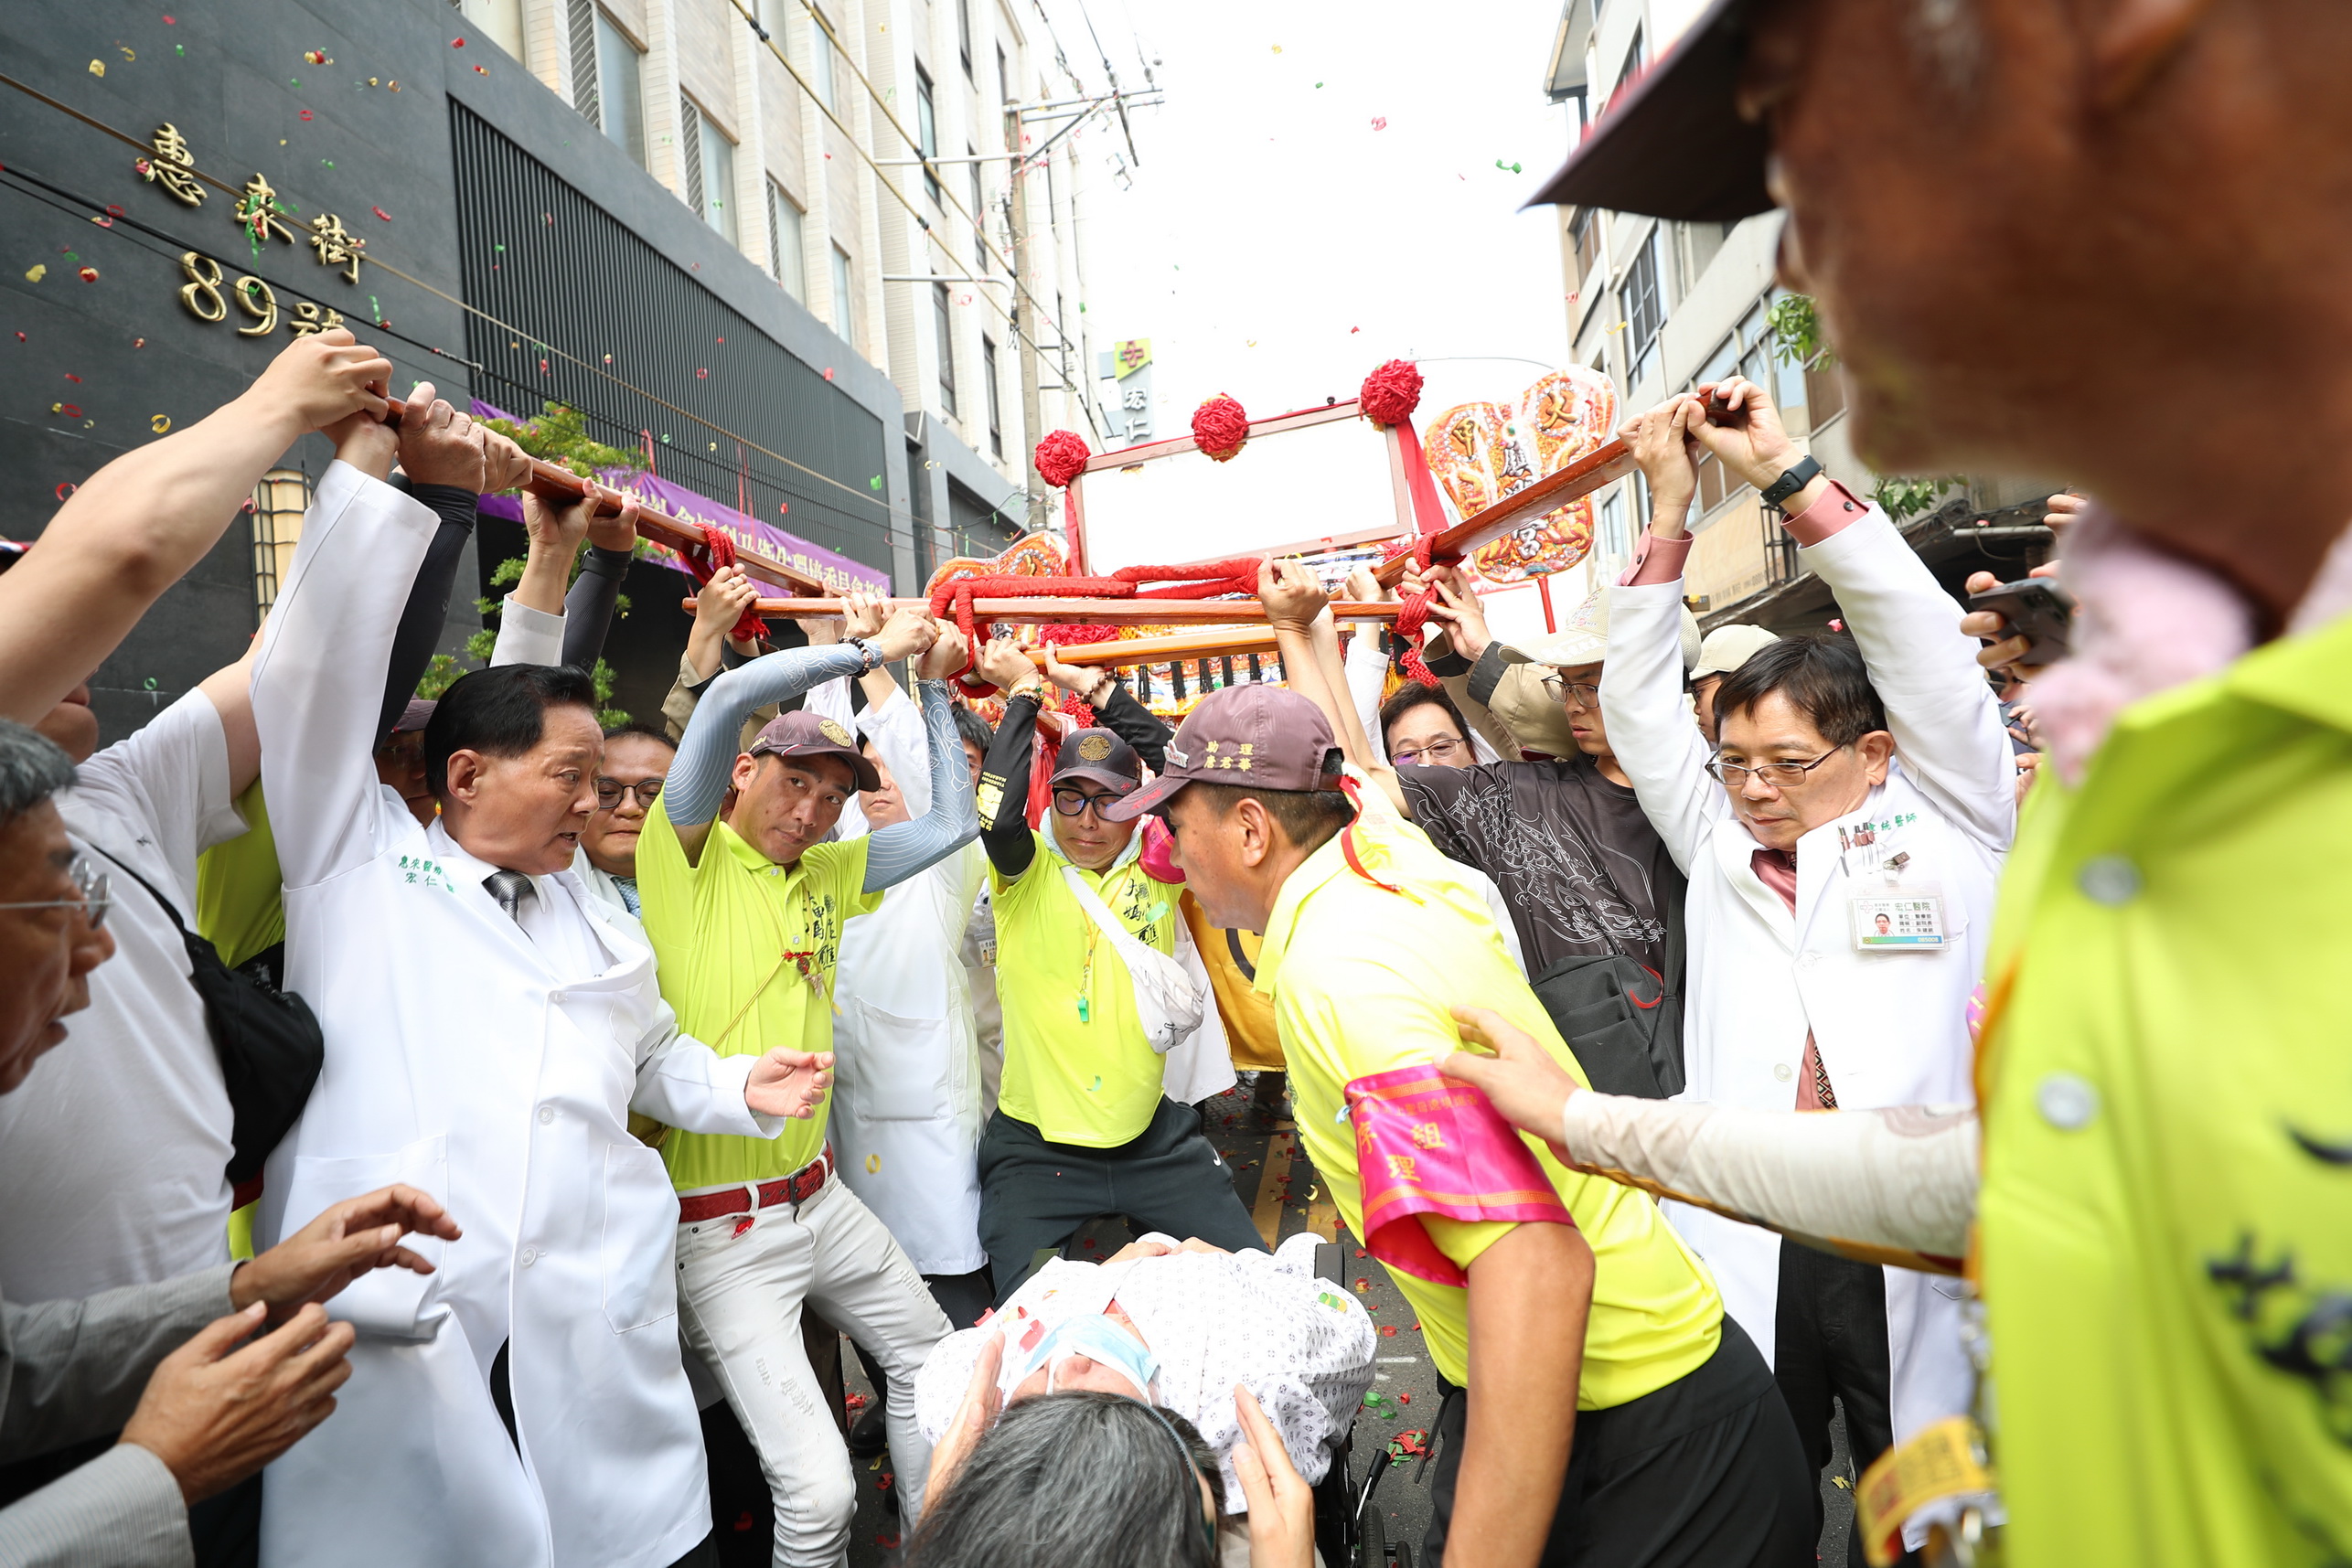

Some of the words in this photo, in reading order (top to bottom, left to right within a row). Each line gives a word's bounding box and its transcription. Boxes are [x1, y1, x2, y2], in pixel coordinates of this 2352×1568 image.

[1123, 386, 1152, 443] 宏仁
[1205, 740, 1254, 756] 助理
[1895, 901, 1931, 911] 宏仁醫院
